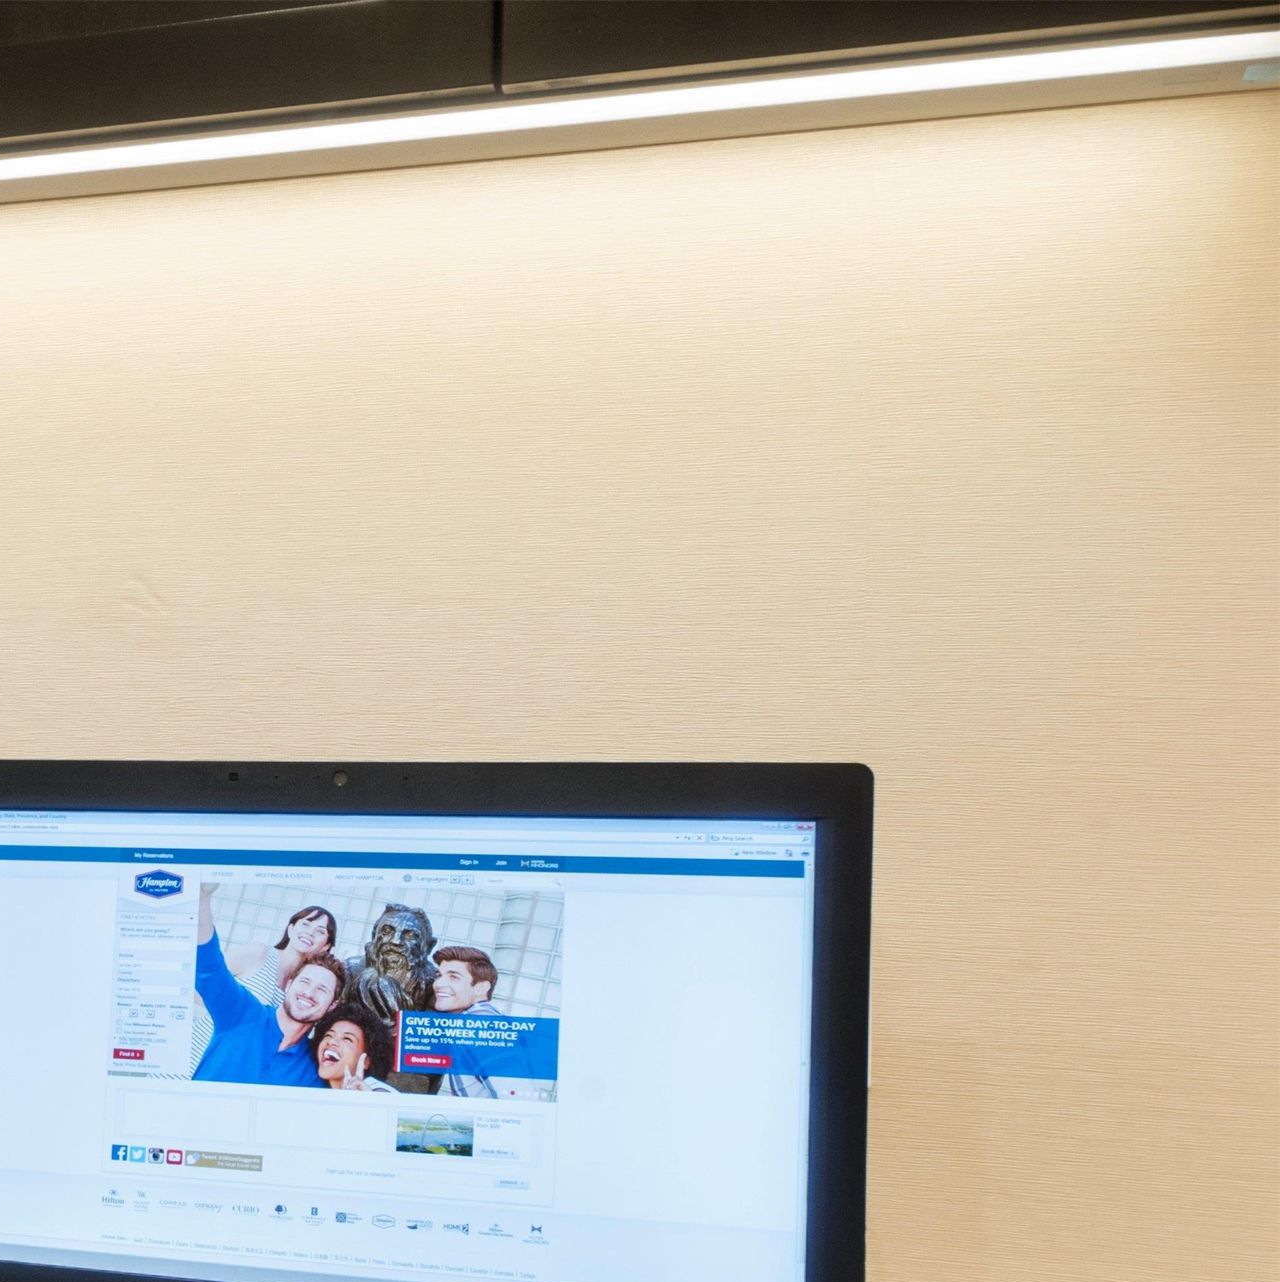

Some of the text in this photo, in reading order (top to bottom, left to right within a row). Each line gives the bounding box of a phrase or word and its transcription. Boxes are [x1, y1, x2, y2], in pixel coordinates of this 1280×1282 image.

[138, 876, 182, 890] Hampton
[406, 1017, 536, 1031] GIVE YOUR DAY-TO-DAY
[405, 1027, 518, 1041] A TWO-WEEK NOTICE
[102, 1196, 125, 1205] Hilton
[232, 1206, 259, 1214] CURIO
